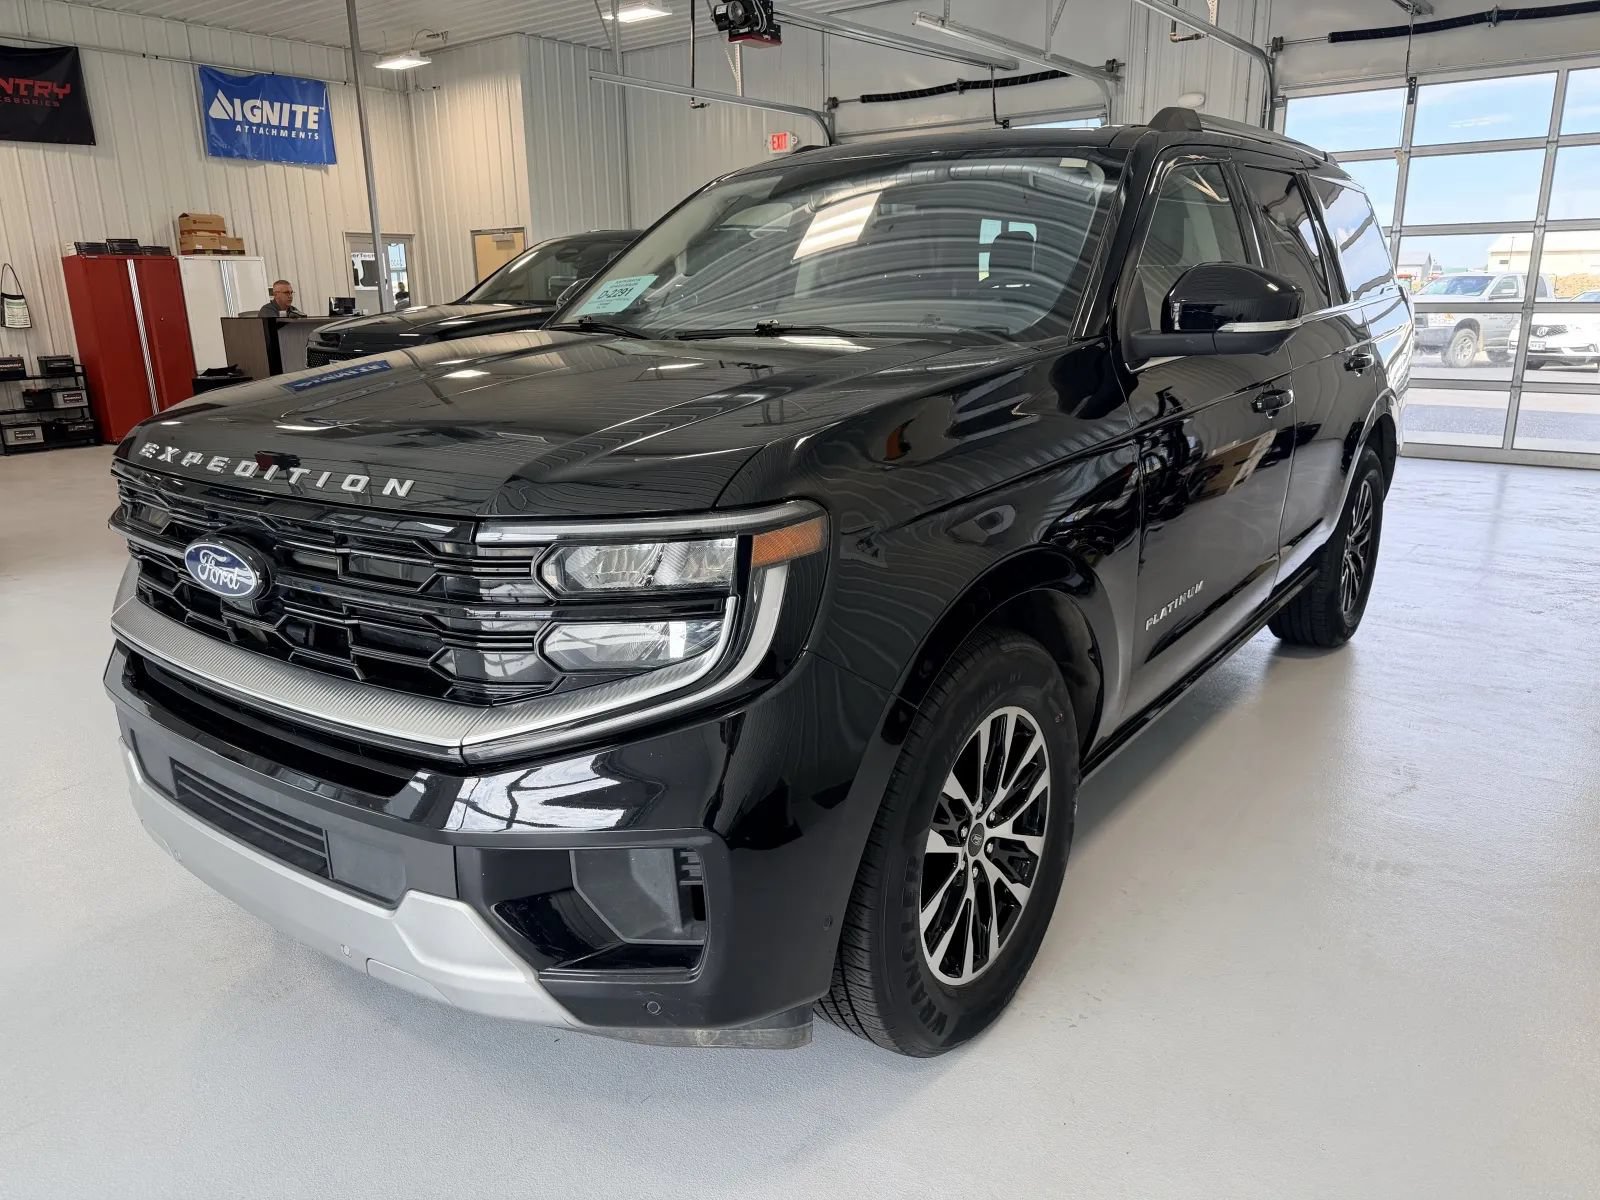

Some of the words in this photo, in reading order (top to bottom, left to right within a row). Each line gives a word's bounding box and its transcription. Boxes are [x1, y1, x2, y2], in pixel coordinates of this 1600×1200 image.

[0, 96, 60, 107] SSORIES
[233, 98, 319, 129] IGNITE
[235, 124, 319, 139] ATTACHMENTS
[771, 133, 788, 150] EXIT
[139, 441, 415, 498] EXPEDITION
[197, 549, 246, 590] Ford
[1145, 580, 1204, 631] PLATINUM
